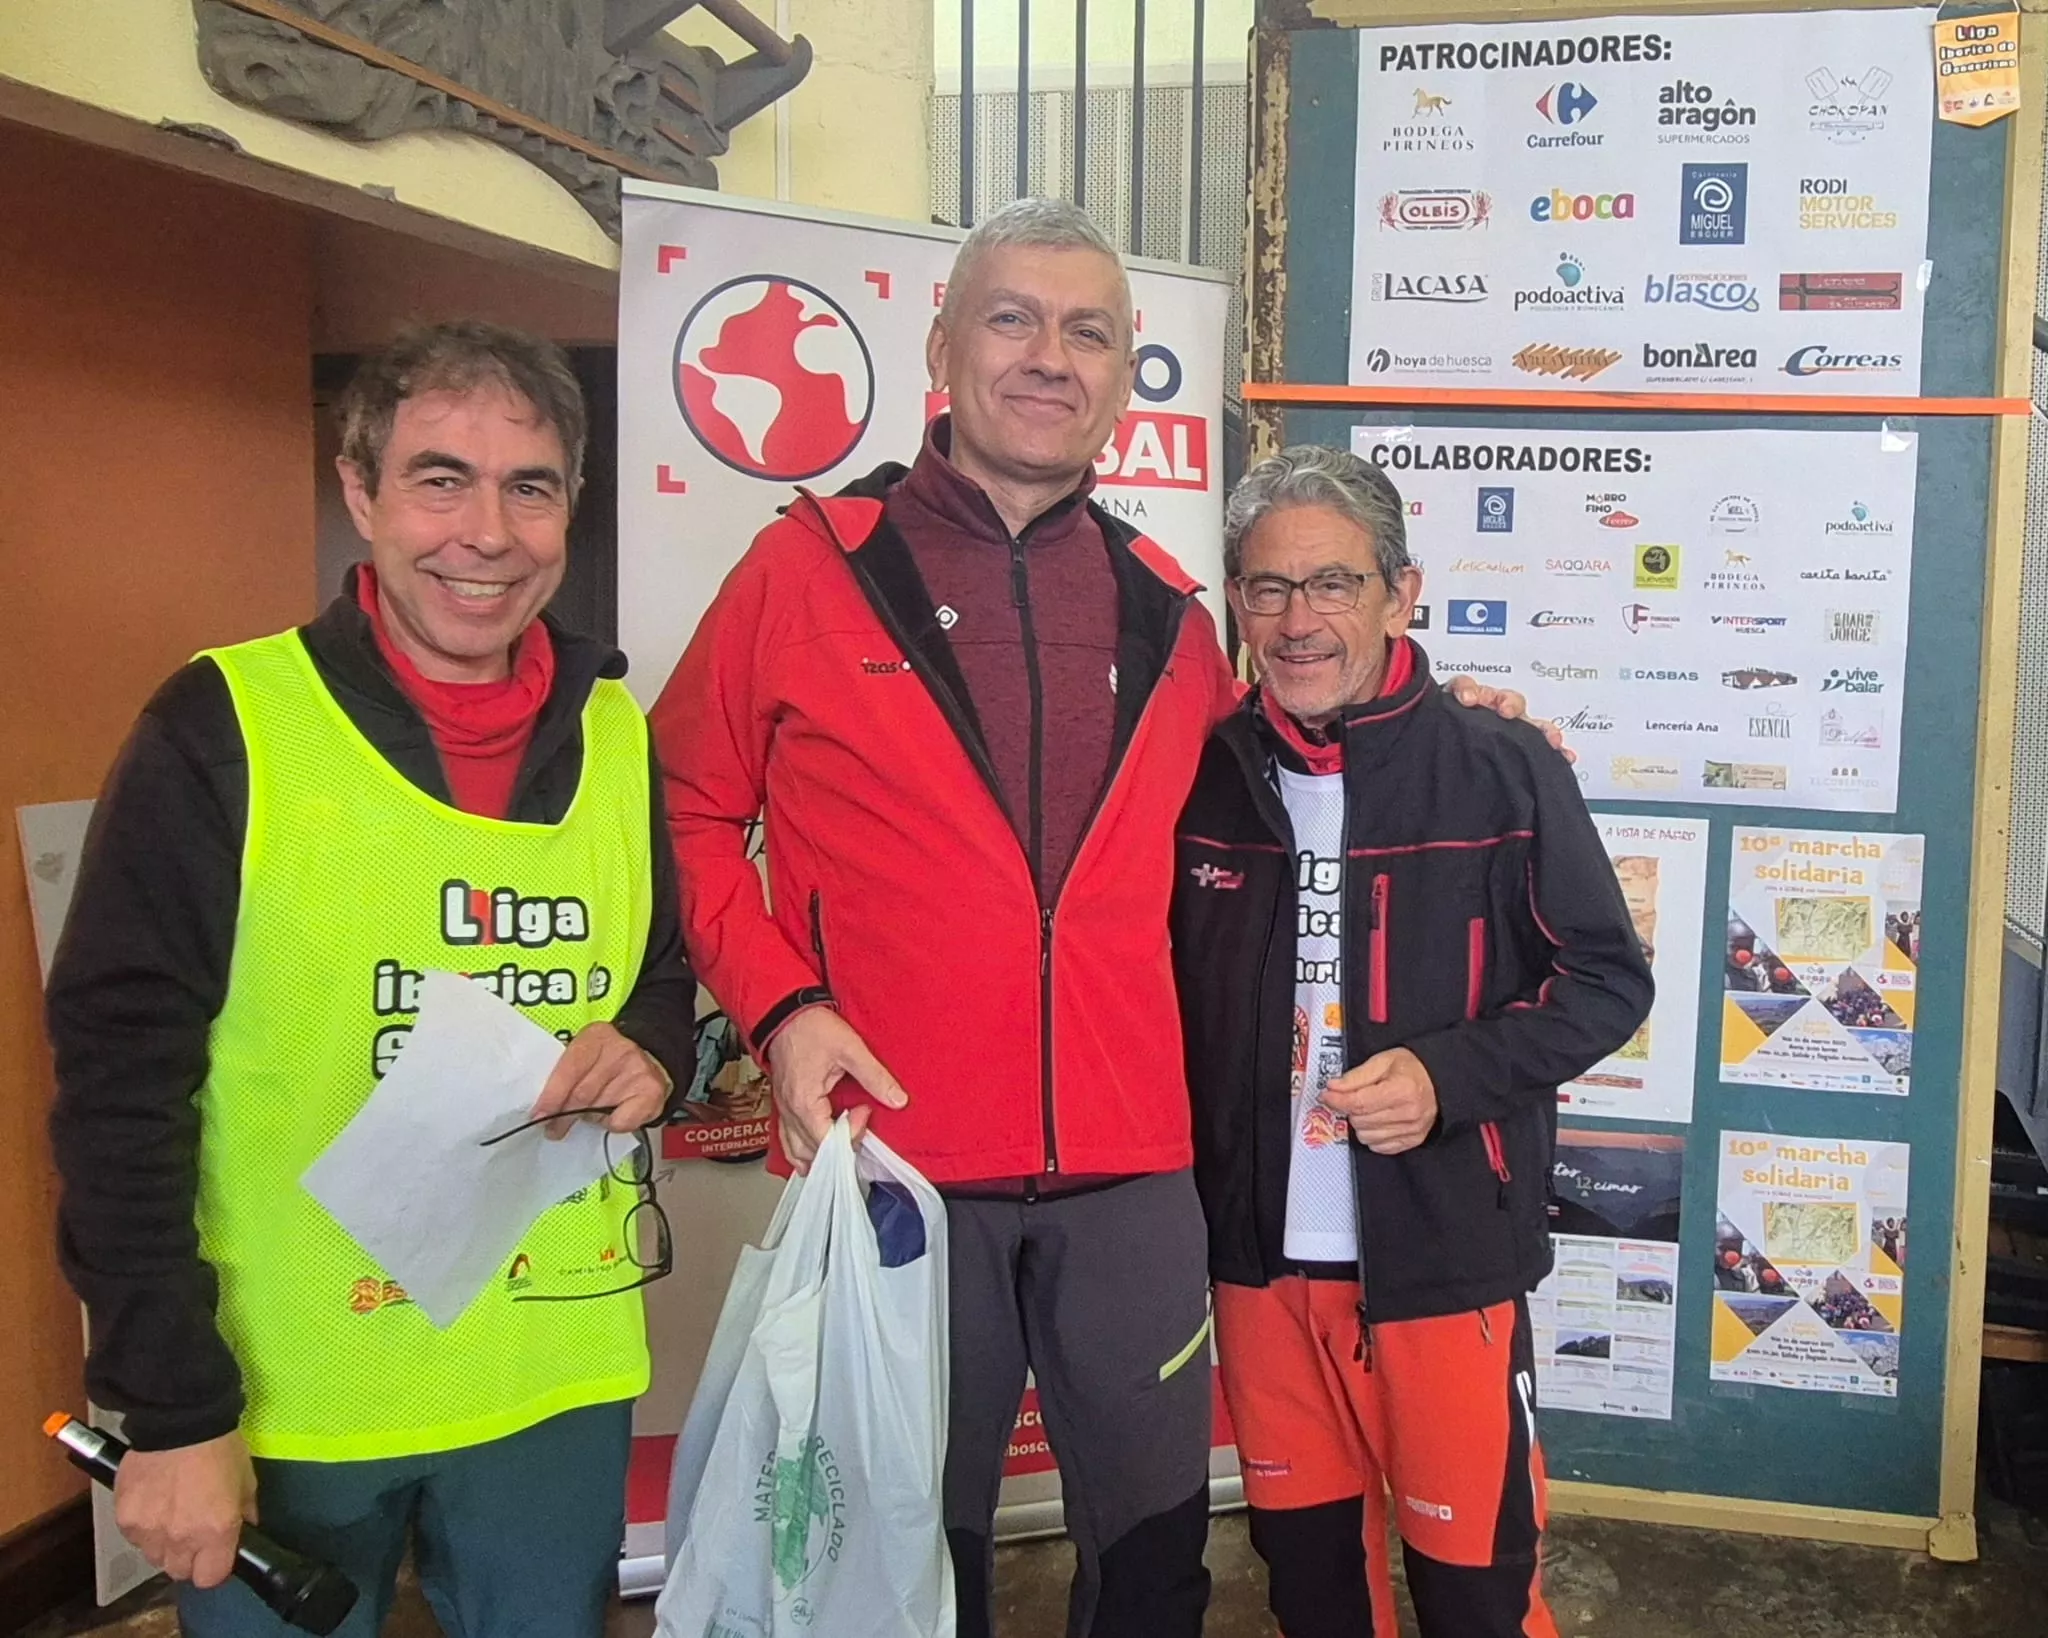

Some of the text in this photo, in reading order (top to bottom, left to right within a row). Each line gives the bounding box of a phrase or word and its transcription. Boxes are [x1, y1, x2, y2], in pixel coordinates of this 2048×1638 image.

[1380, 34, 1672, 71] PATROCINADORES:
[1659, 80, 1713, 104] alto
[1393, 126, 1464, 138] BODEGA
[1527, 132, 1604, 148] Carrefour
[1658, 134, 1751, 144] SUPERMERCADOS
[1383, 139, 1475, 151] PIRINEOS
[1800, 179, 1848, 195] RODI
[1530, 188, 1635, 223] eboca
[1800, 196, 1874, 213] MOTOR
[1691, 214, 1734, 231] MIGUEL
[1799, 213, 1897, 230] SERVICES
[1384, 273, 1489, 303] LACASA
[1645, 274, 1752, 308] blasco
[1514, 285, 1625, 312] podoactiva
[1394, 354, 1493, 368] hoya de huesca
[1784, 345, 1903, 376] Correas
[1371, 444, 1652, 473] COLABORADORES:
[1585, 504, 1612, 513] FINO
[1825, 520, 1894, 535] podoactiva
[1545, 559, 1612, 571] SAQQARA
[1703, 581, 1766, 590] PIRINEOS
[1710, 573, 1760, 582] BODEGA
[1722, 616, 1788, 627] INTERSPORT
[1435, 661, 1512, 674] Saccohuesca
[1635, 670, 1699, 681] CASBAS
[1846, 667, 1879, 681] vive
[1845, 680, 1885, 694] balar
[1646, 720, 1720, 733] Lencería Ana
[1749, 717, 1792, 739] ESENCIA
[1616, 827, 1640, 838] VISTA
[1643, 829, 1657, 840] DE
[1789, 836, 1882, 858] marcha
[1755, 860, 1865, 885] solidaria
[440, 879, 589, 948] Liga
[1776, 1144, 1868, 1166] marcha
[1742, 1164, 1851, 1191] solidaria
[815, 1435, 847, 1563] RECICLADO
